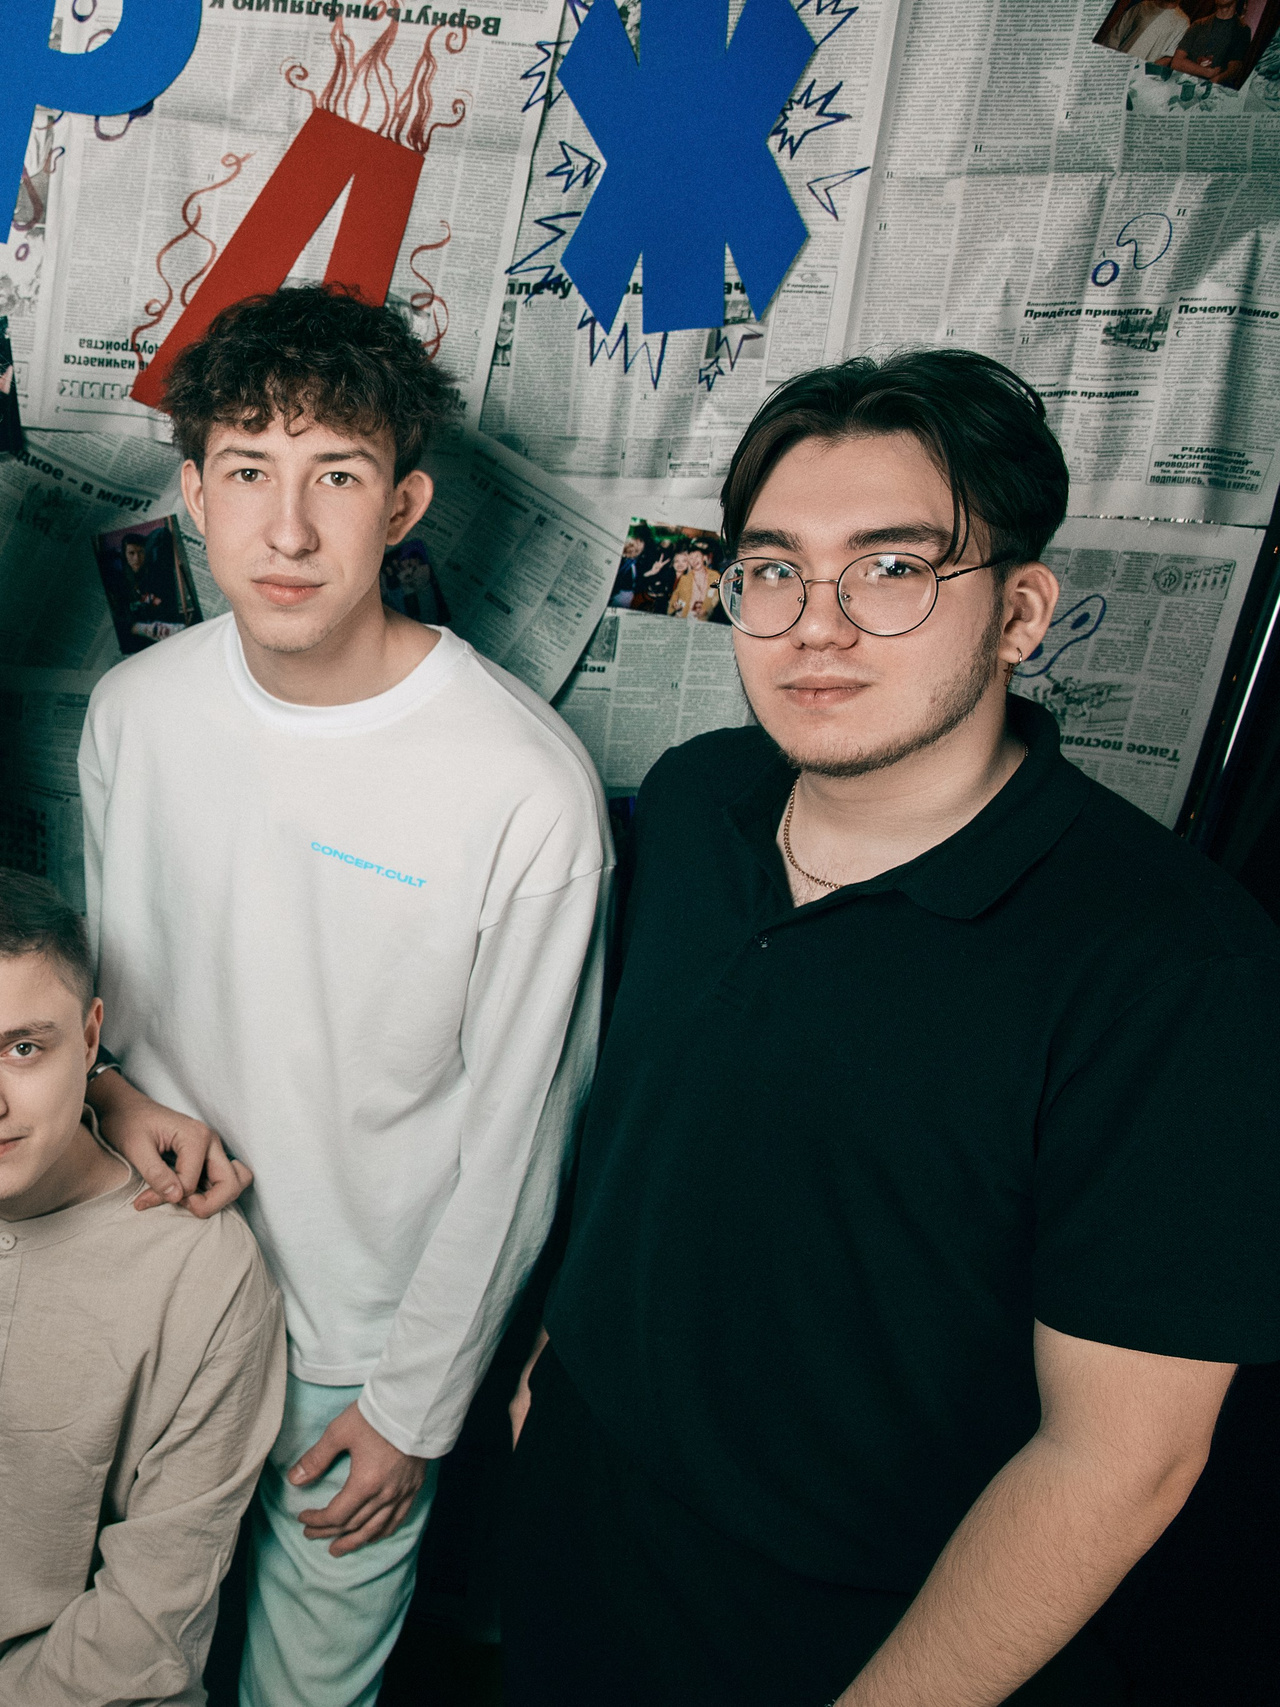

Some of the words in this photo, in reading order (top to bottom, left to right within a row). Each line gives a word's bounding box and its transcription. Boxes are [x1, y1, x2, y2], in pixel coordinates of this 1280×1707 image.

[385, 6, 502, 37] Вернуть
[1023, 307, 1083, 319] Придётся
[1084, 306, 1154, 318] привыкать
[1177, 304, 1237, 315] Почему
[63, 354, 136, 370] начинается
[1079, 389, 1140, 399] праздника
[1153, 460, 1200, 469] ПРОВОДИТ
[97, 488, 153, 514] меру!
[1126, 742, 1180, 763] Такое
[310, 841, 427, 888] CONCEPT.CULT
